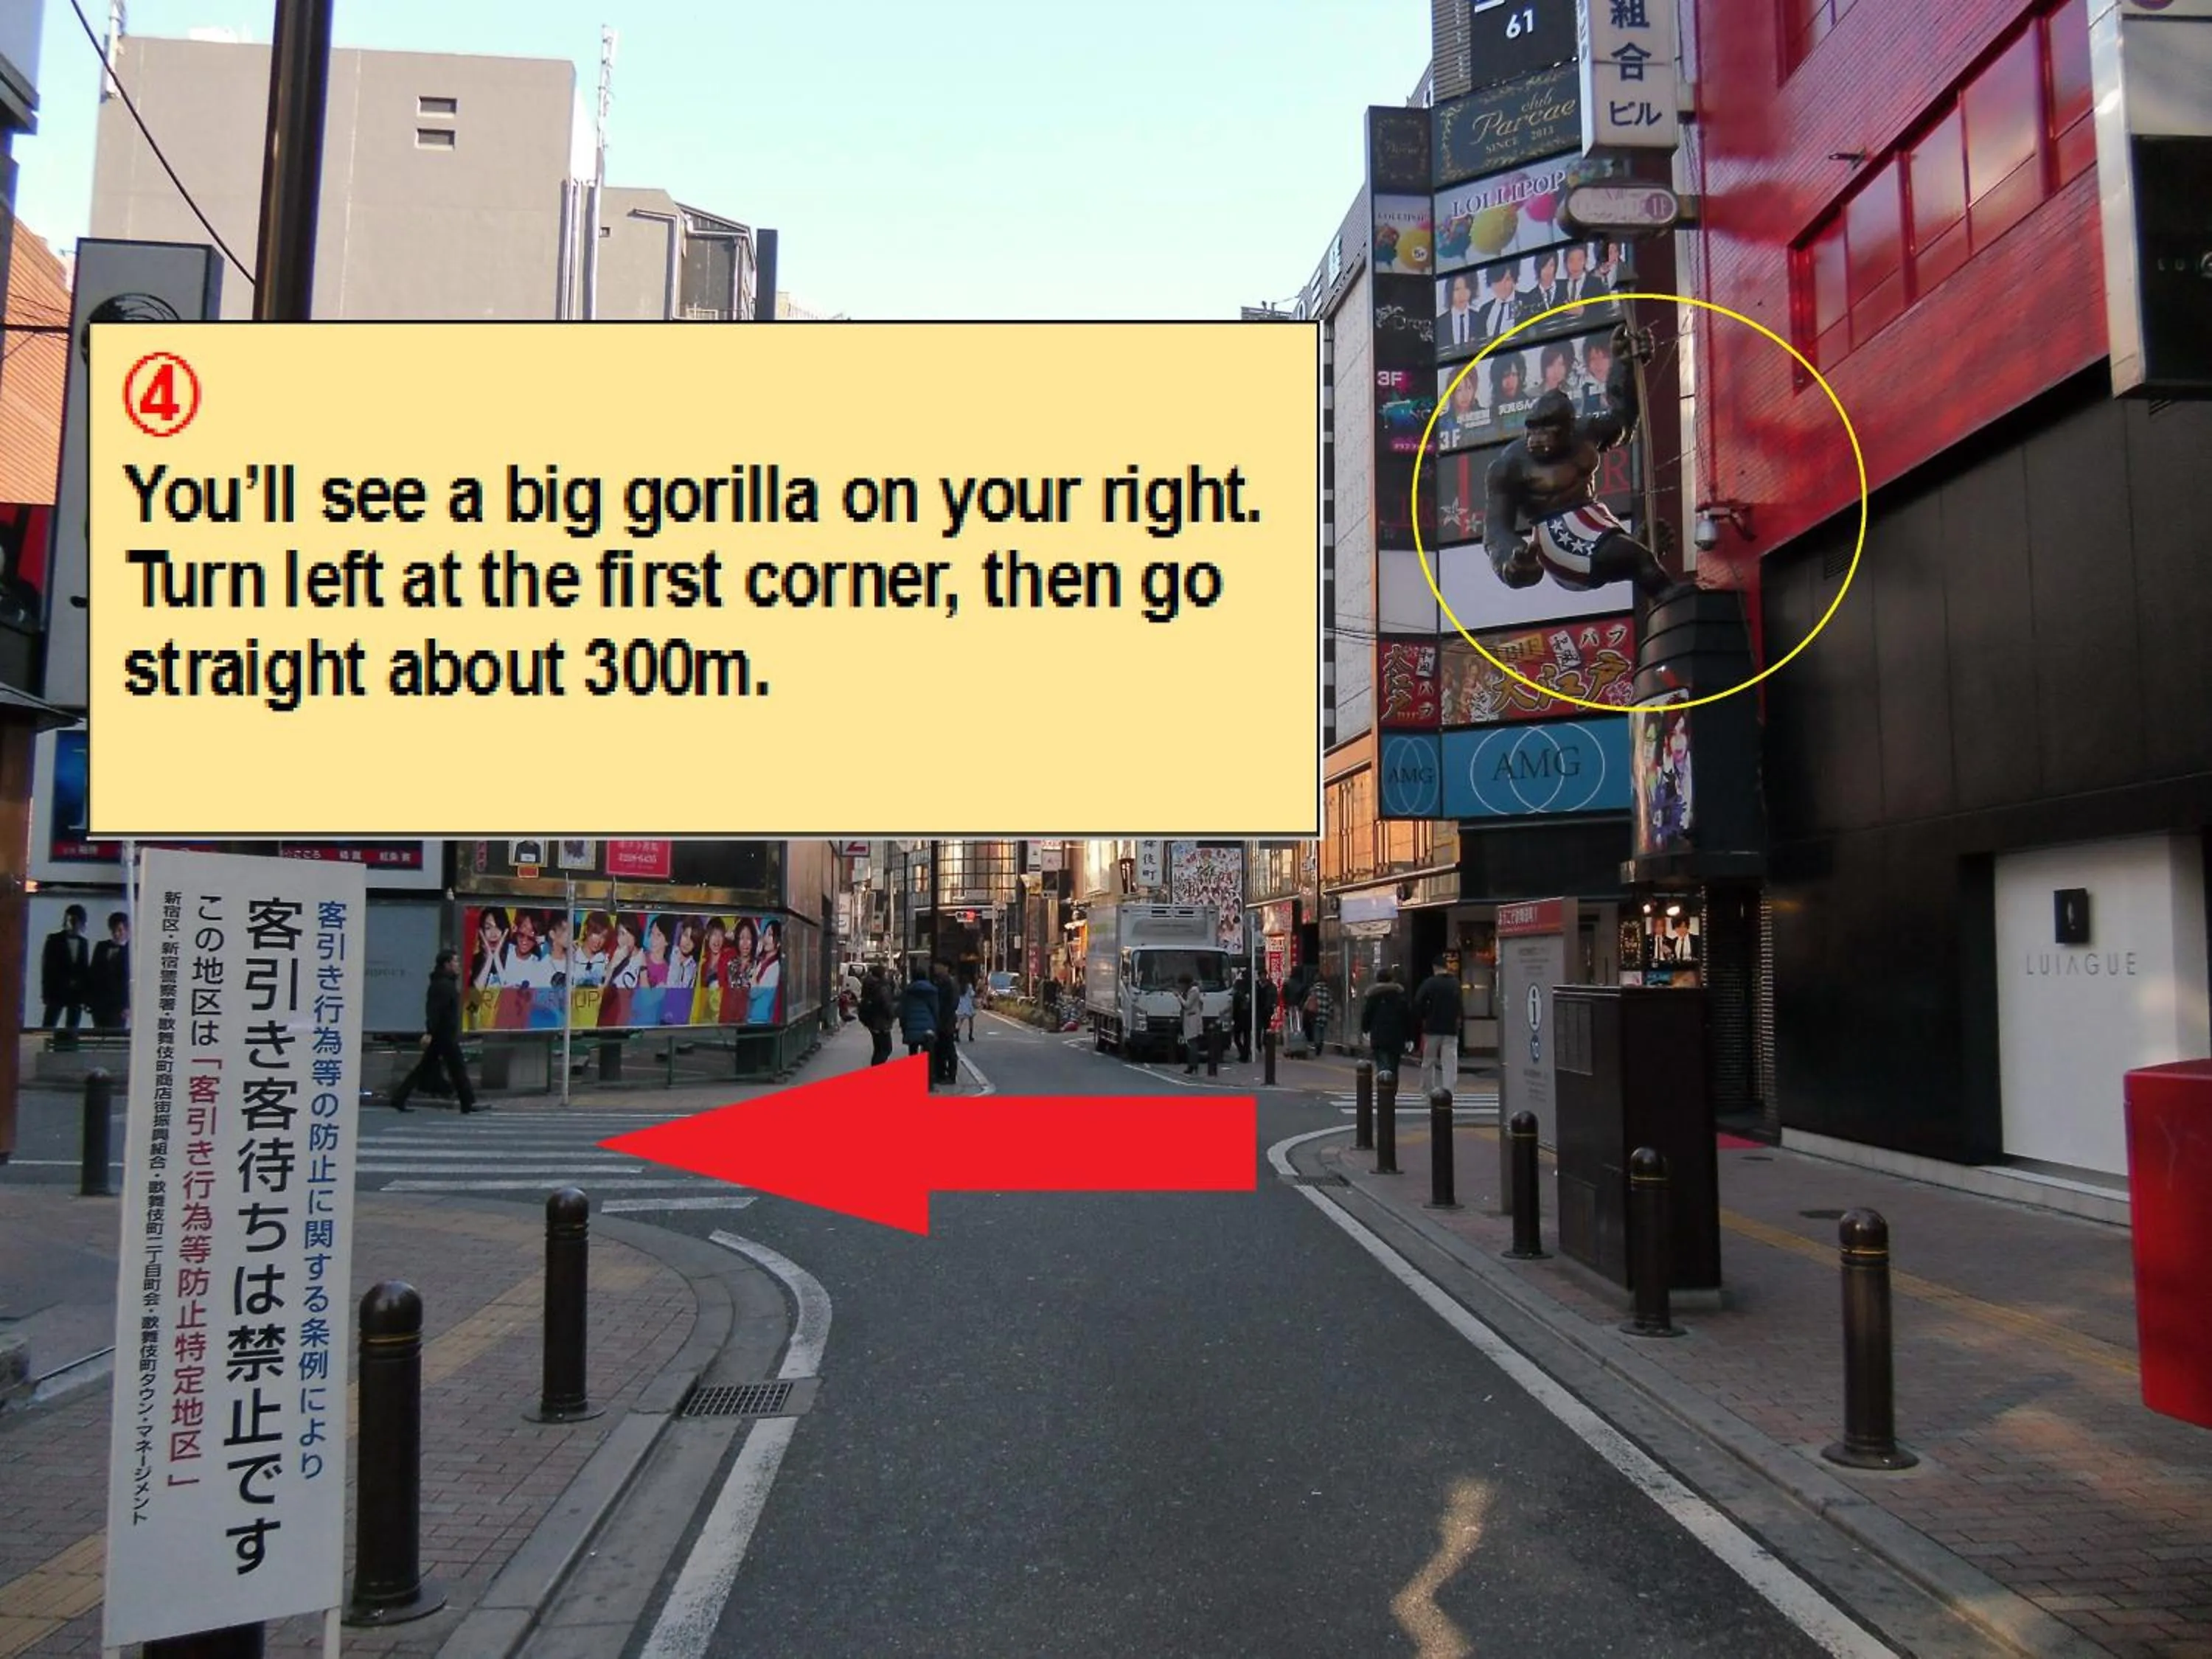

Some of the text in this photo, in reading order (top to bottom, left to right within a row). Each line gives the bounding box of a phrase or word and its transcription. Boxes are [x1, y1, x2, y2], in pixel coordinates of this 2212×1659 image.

[1506, 10, 1534, 39] 61
[1521, 88, 1552, 111] club
[1450, 170, 1567, 220] LOLLIPOP
[1377, 371, 1402, 386] 3F
[1388, 765, 1433, 785] AMG
[1492, 746, 1581, 781] AMG
[167, 895, 225, 1486] この地区は「客引き行為等防止特定地区」
[298, 900, 347, 1480] 客引き行為等の防止に関する条例により
[223, 897, 303, 1576] 客引き客待ちは禁止です
